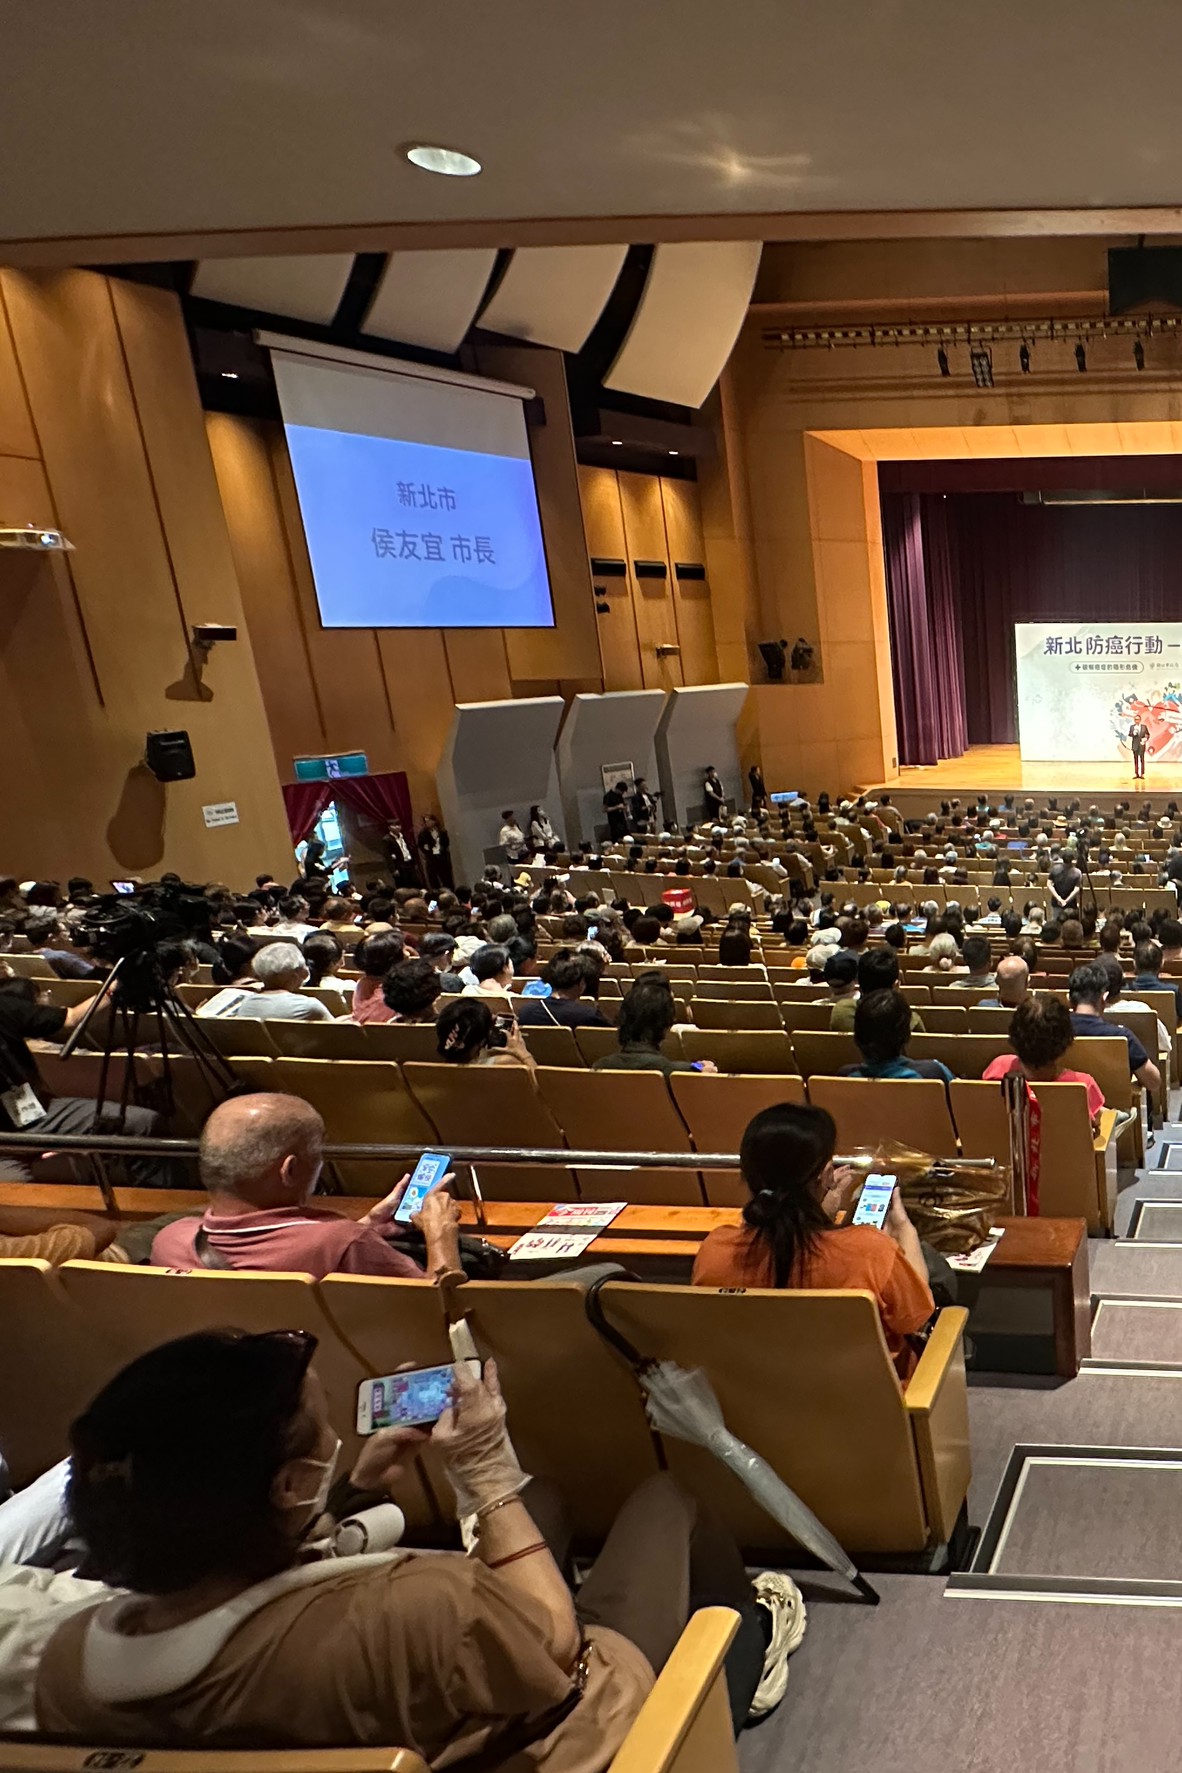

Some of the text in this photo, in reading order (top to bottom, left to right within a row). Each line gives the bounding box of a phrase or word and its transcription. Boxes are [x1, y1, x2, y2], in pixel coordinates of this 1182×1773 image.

[396, 480, 457, 512] 新北市
[370, 527, 496, 565] 侯友宜 市長
